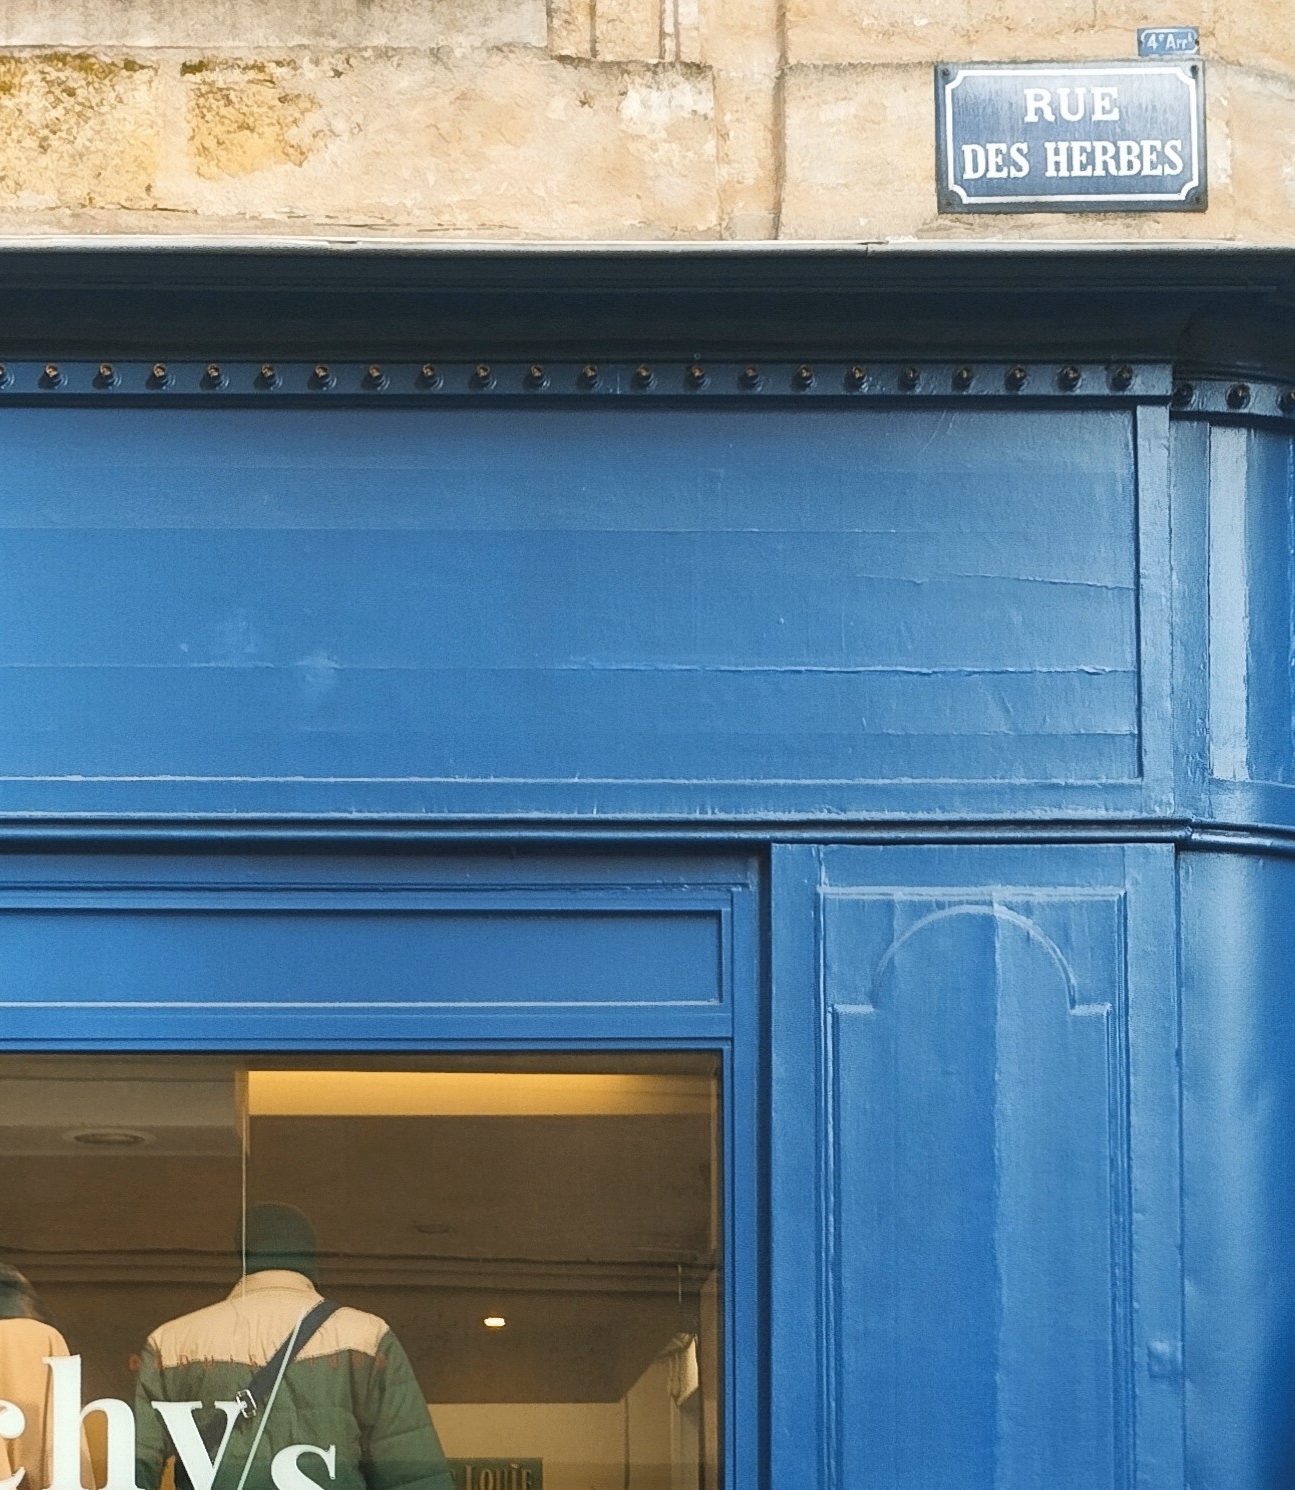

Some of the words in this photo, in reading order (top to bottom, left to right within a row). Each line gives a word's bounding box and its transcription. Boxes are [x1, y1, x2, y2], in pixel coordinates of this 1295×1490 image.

[1023, 86, 1120, 123] RUE
[961, 142, 1030, 180] DES
[1044, 139, 1184, 178] HERBES
